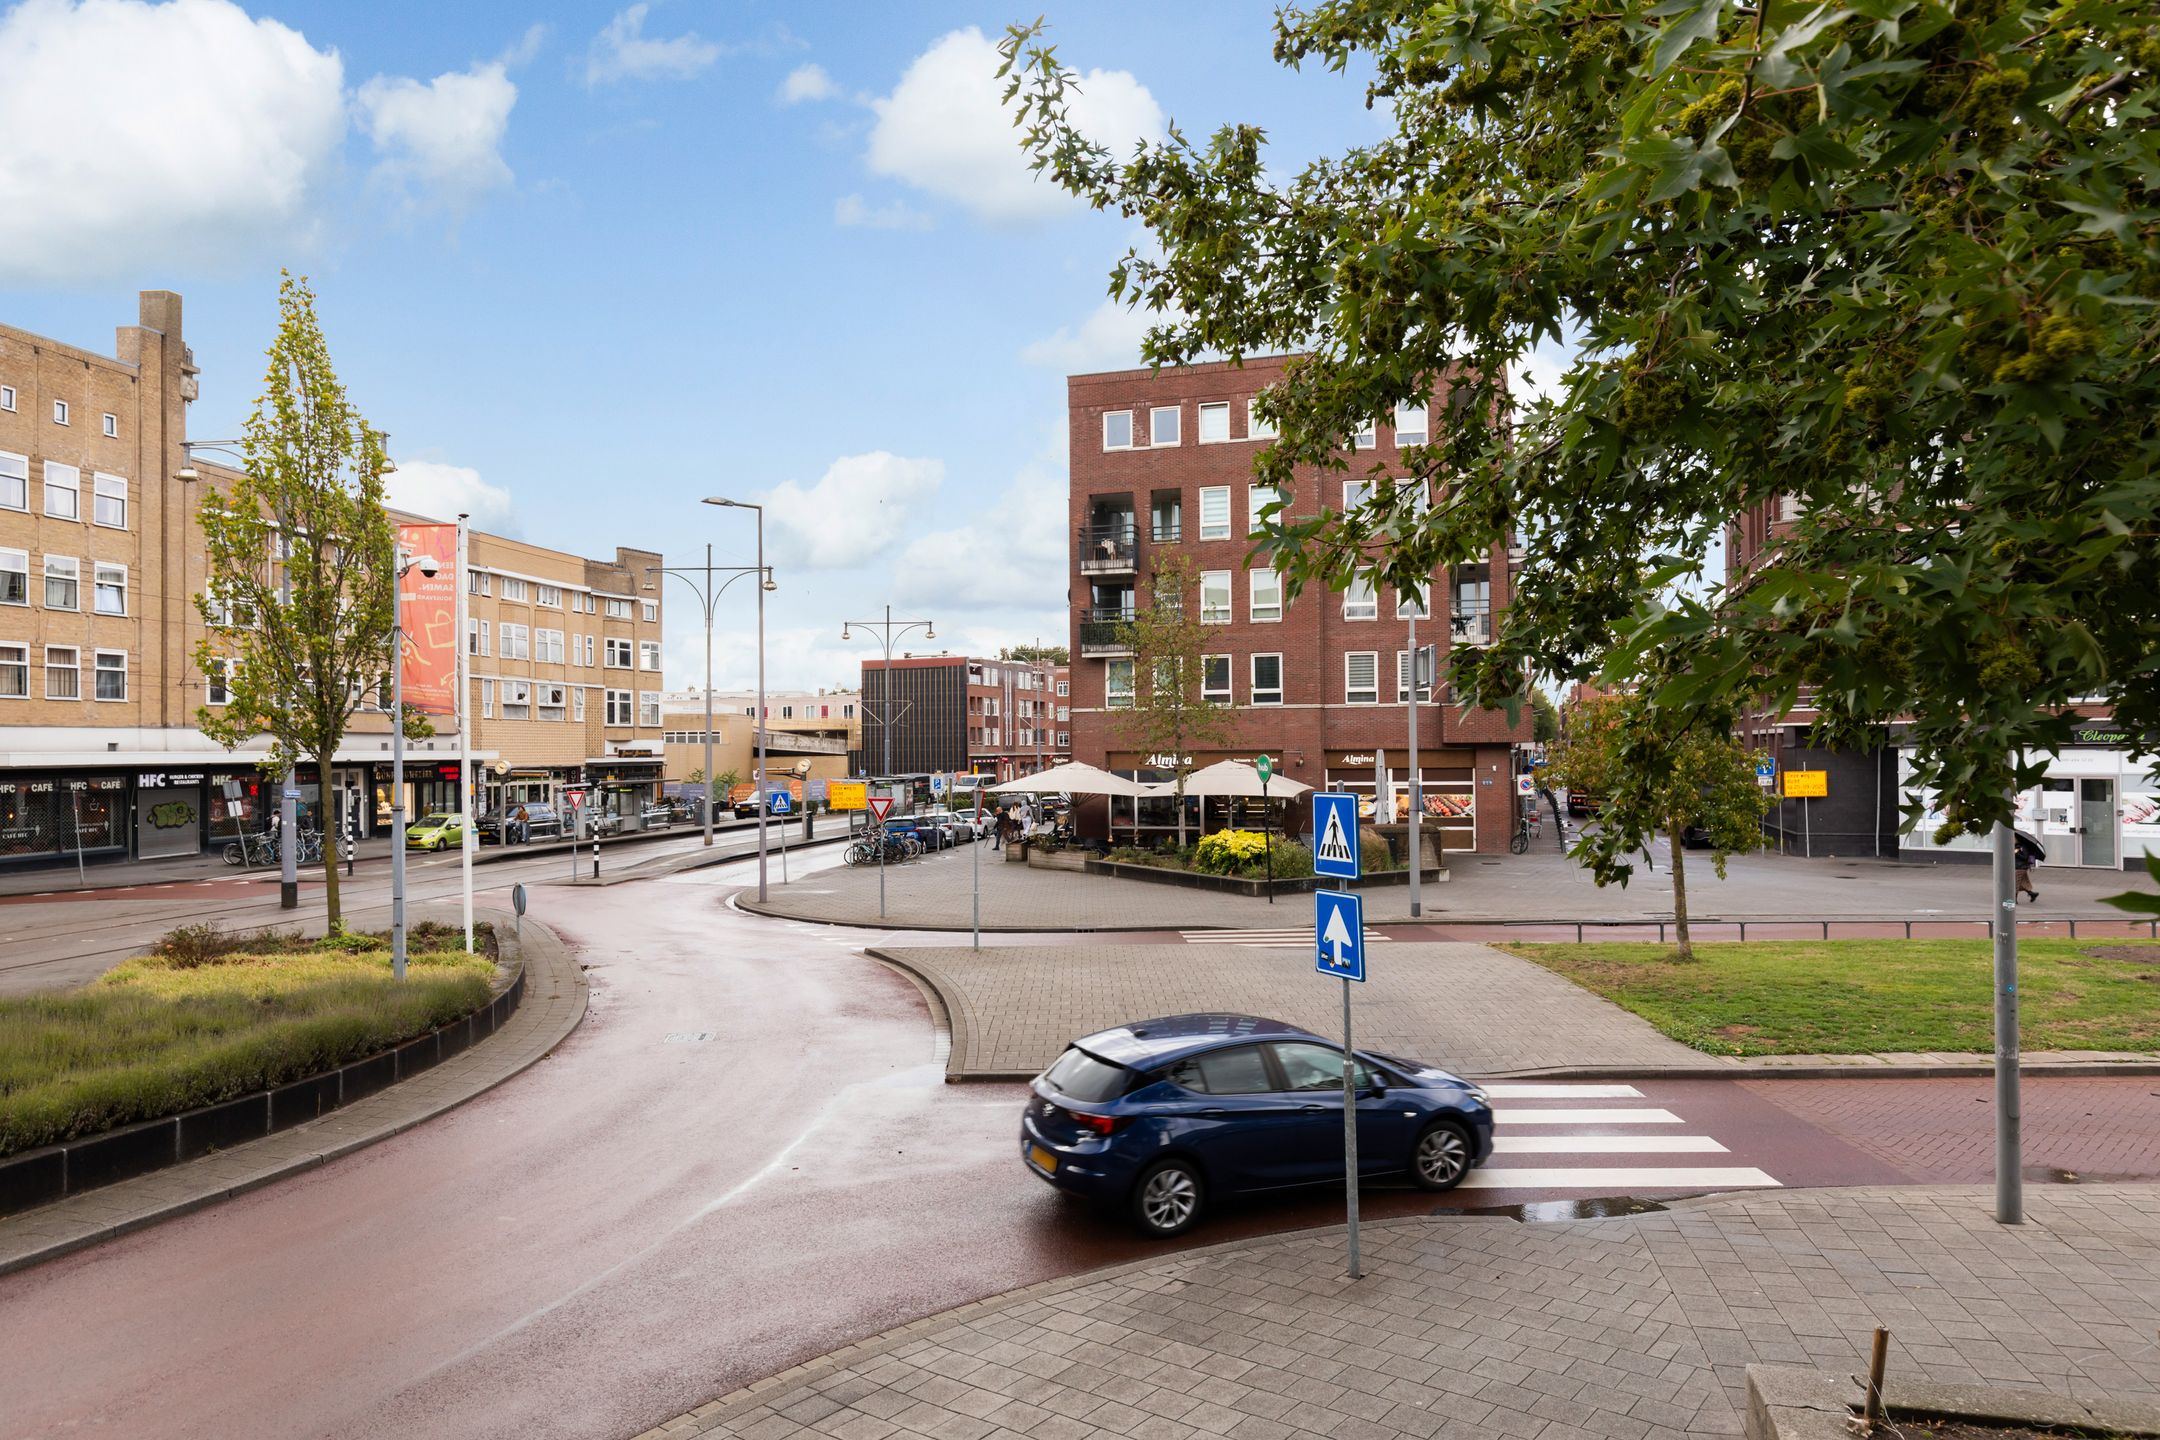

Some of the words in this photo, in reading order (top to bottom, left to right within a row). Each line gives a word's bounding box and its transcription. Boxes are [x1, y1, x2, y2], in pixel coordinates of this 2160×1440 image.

[1145, 753, 1193, 768] Almia
[1341, 754, 1375, 765] Almina
[70, 782, 87, 790] HFC
[138, 774, 166, 787] HFC
